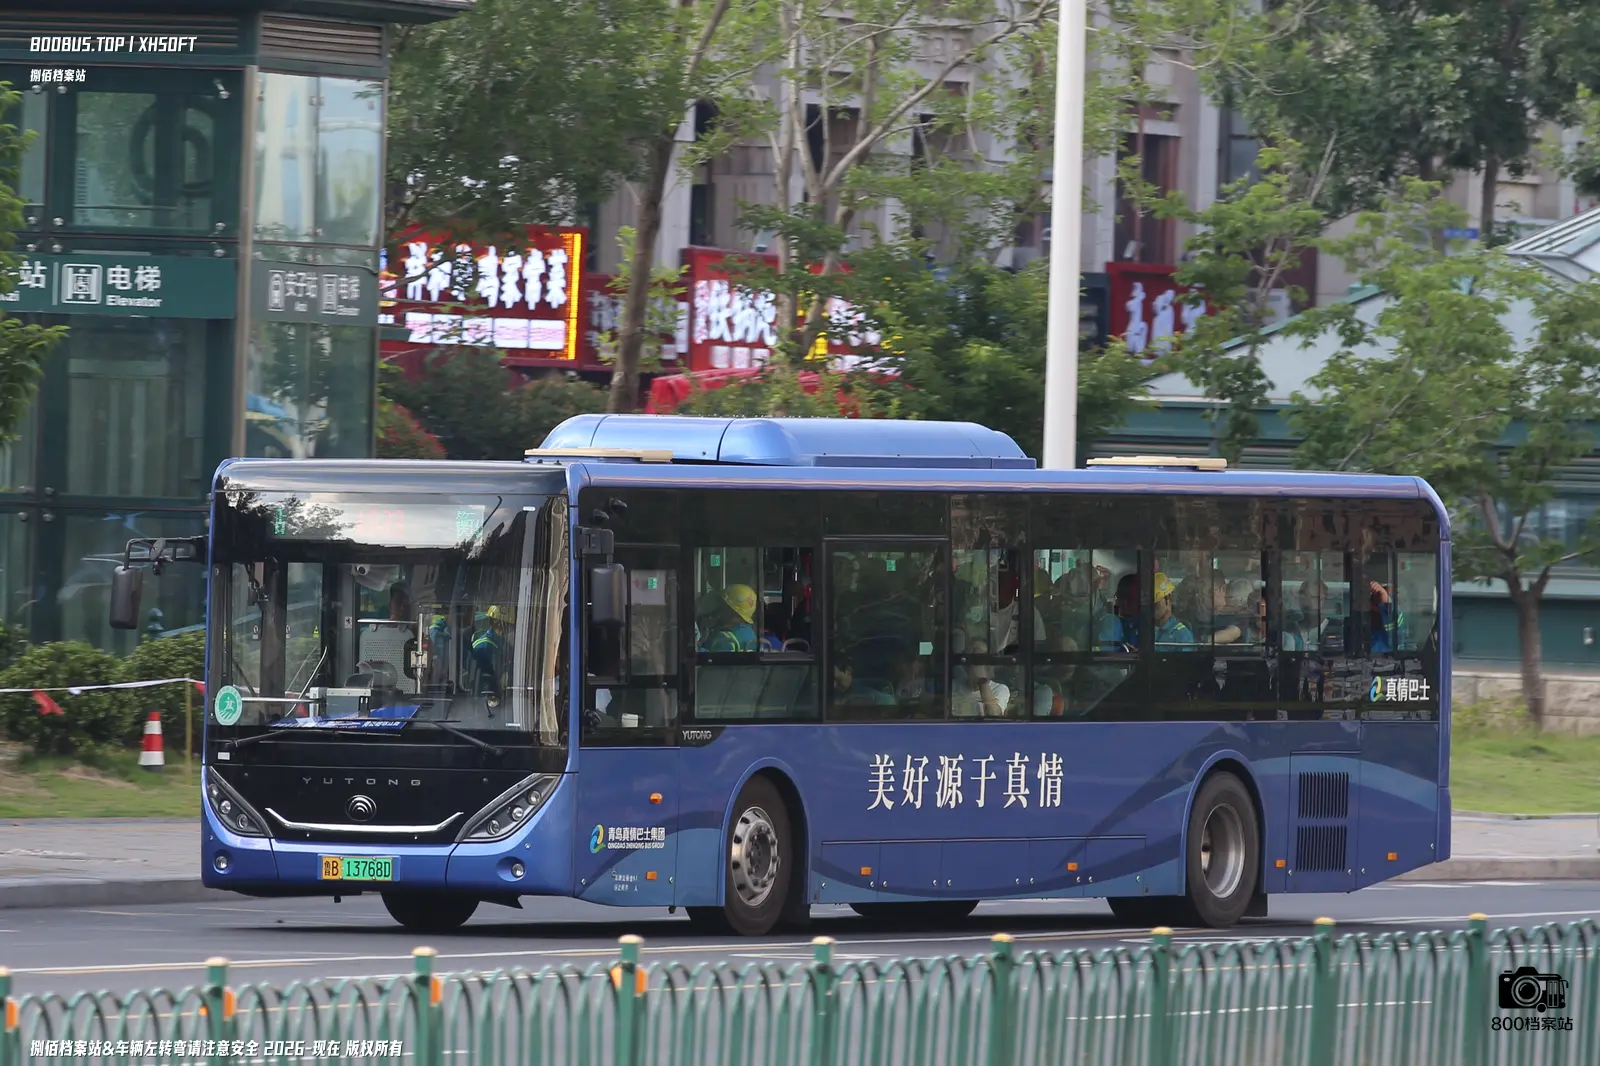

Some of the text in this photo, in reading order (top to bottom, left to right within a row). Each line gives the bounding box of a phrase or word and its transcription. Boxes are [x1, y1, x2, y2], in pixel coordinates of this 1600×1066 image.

[106, 265, 161, 291] 电梯
[106, 295, 162, 307] Elevator
[1385, 678, 1430, 702] 真情巴士
[682, 730, 712, 741] YUTONG
[302, 777, 421, 786] YUTONG
[867, 752, 1064, 811] 美好源于真情
[608, 827, 665, 841] 青岛真情巴士集团
